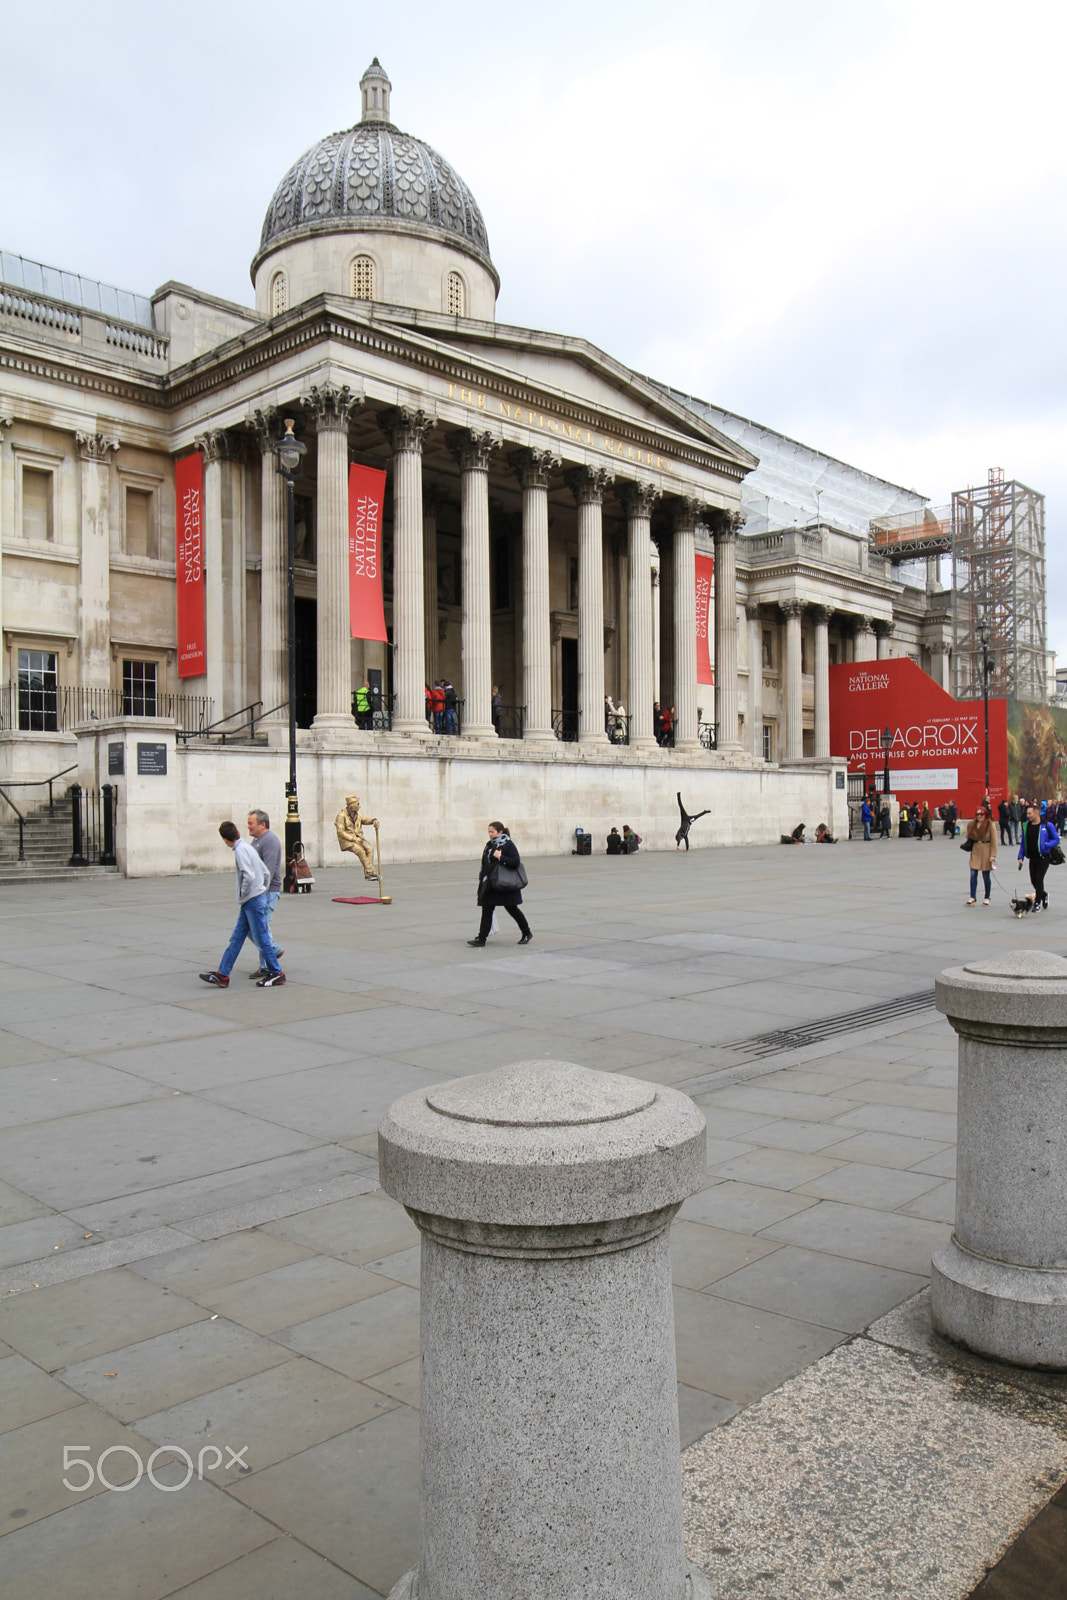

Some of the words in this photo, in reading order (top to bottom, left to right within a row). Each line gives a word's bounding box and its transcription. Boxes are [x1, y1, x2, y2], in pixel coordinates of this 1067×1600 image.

[444, 382, 486, 409] THE
[499, 400, 594, 446] NATIONAL
[605, 437, 675, 472] GALLERY
[183, 488, 193, 584] NATIONAL
[191, 487, 201, 582] GALLERY
[355, 495, 368, 576] NATIONAL
[365, 496, 379, 579] GALLERY
[700, 577, 709, 638] GALLERY
[849, 673, 889, 684] NATIONAL
[849, 681, 889, 692] GALLERY
[849, 722, 978, 751] DELACROIX
[850, 752, 868, 760] AND
[871, 751, 885, 759] THE
[888, 750, 905, 758] RISE
[907, 749, 919, 757] OF
[922, 748, 959, 757] MODERN
[961, 746, 978, 755] ART
